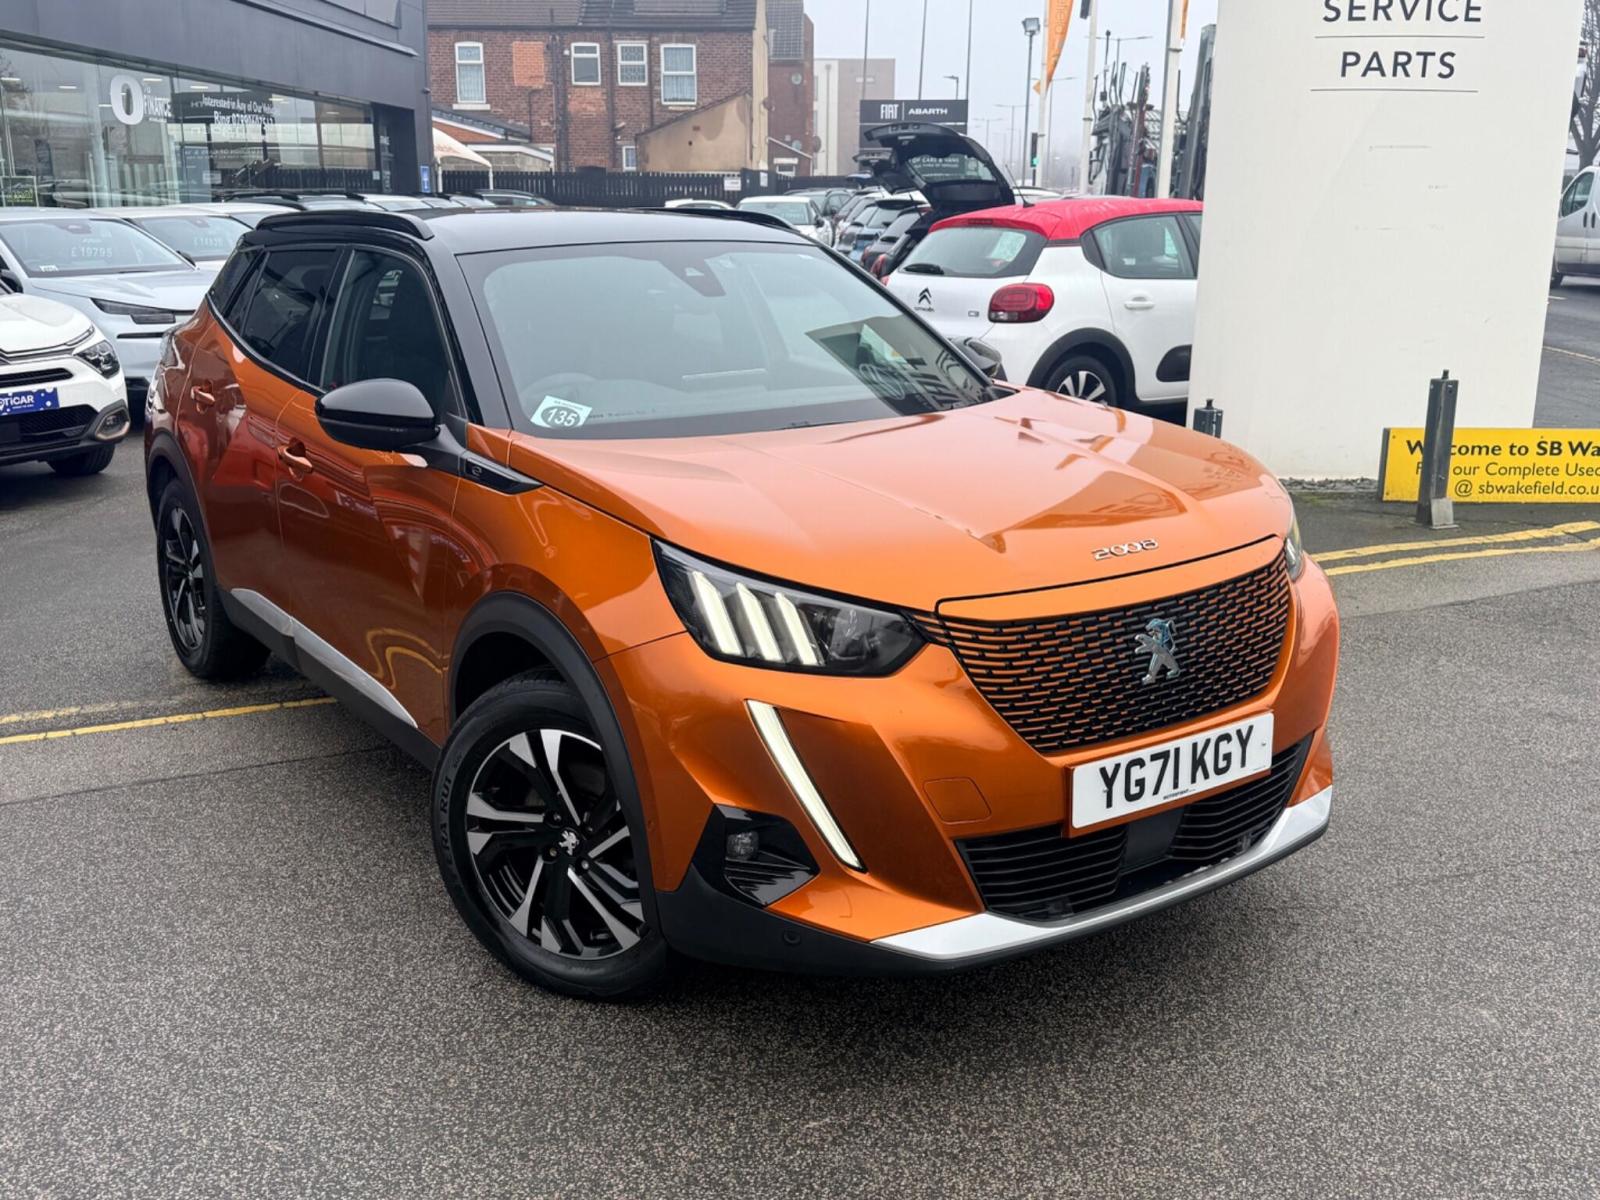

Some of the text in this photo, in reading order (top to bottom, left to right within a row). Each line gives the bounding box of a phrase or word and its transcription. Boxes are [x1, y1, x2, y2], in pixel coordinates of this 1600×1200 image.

[1323, 0, 1482, 22] SERVICE
[1341, 51, 1456, 78] PARTS
[880, 104, 898, 119] FIAT
[546, 406, 578, 427] 135
[1406, 440, 1502, 456] Wcome
[1509, 443, 1529, 456] to
[1536, 440, 1563, 456] SB
[1485, 462, 1560, 480] Complete
[1455, 479, 1473, 497] @
[1091, 538, 1159, 561] 2008
[1099, 724, 1254, 809] YG71 KGY
